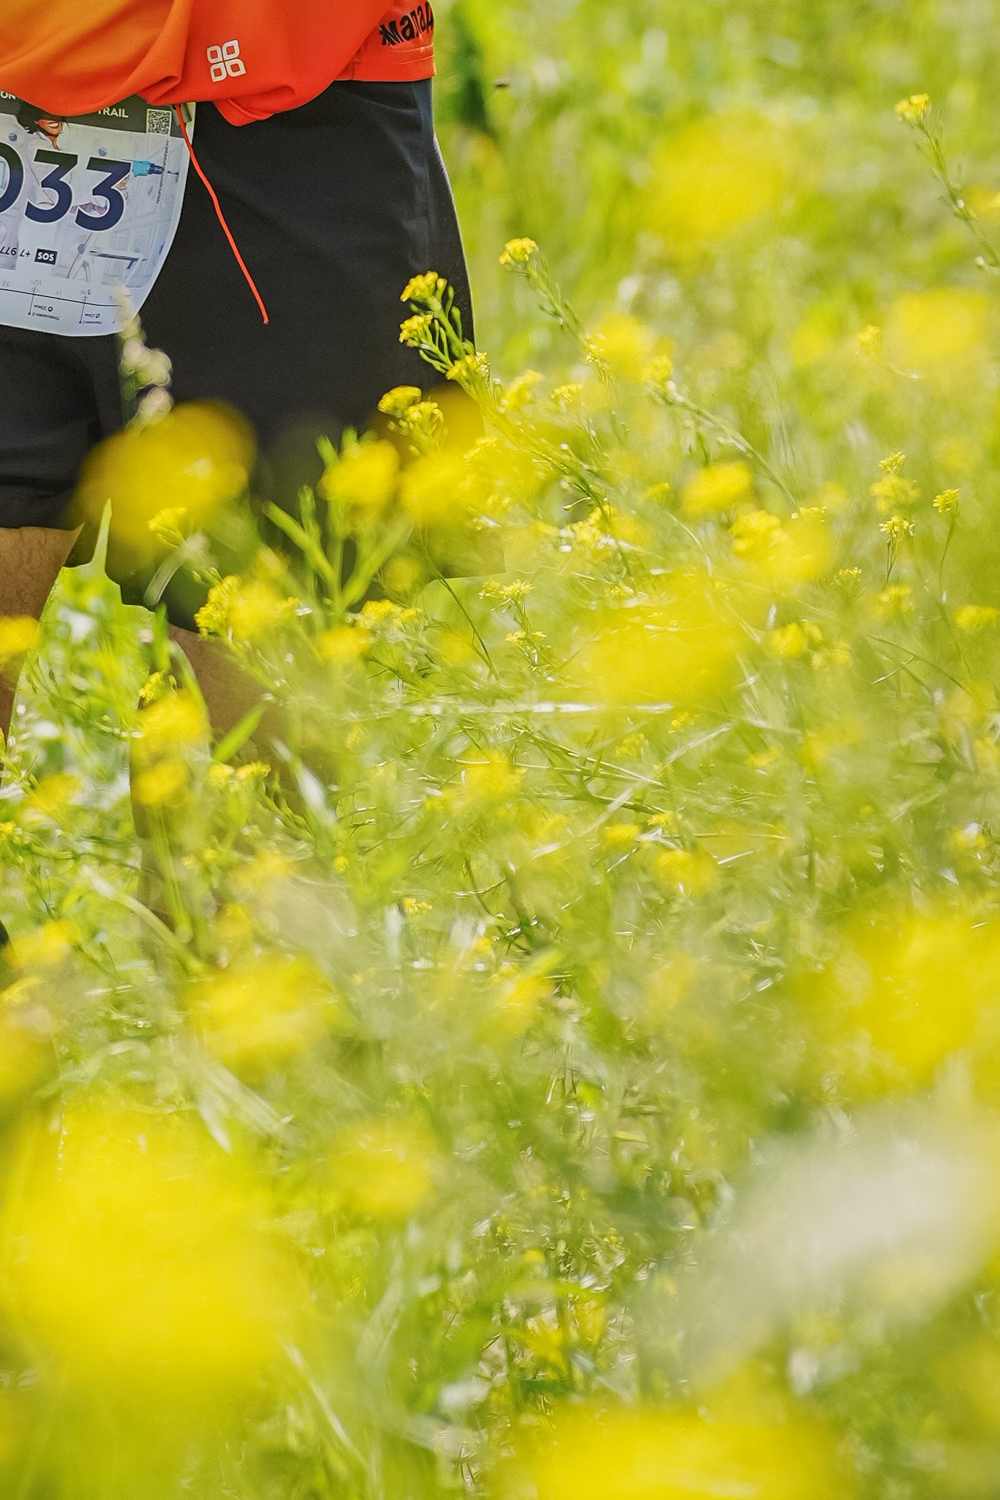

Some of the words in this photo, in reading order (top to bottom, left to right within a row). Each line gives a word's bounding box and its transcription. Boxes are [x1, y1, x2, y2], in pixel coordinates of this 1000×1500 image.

[0, 245, 17, 256] 977
[19, 249, 31, 258] +7
[36, 251, 55, 262] SOS
